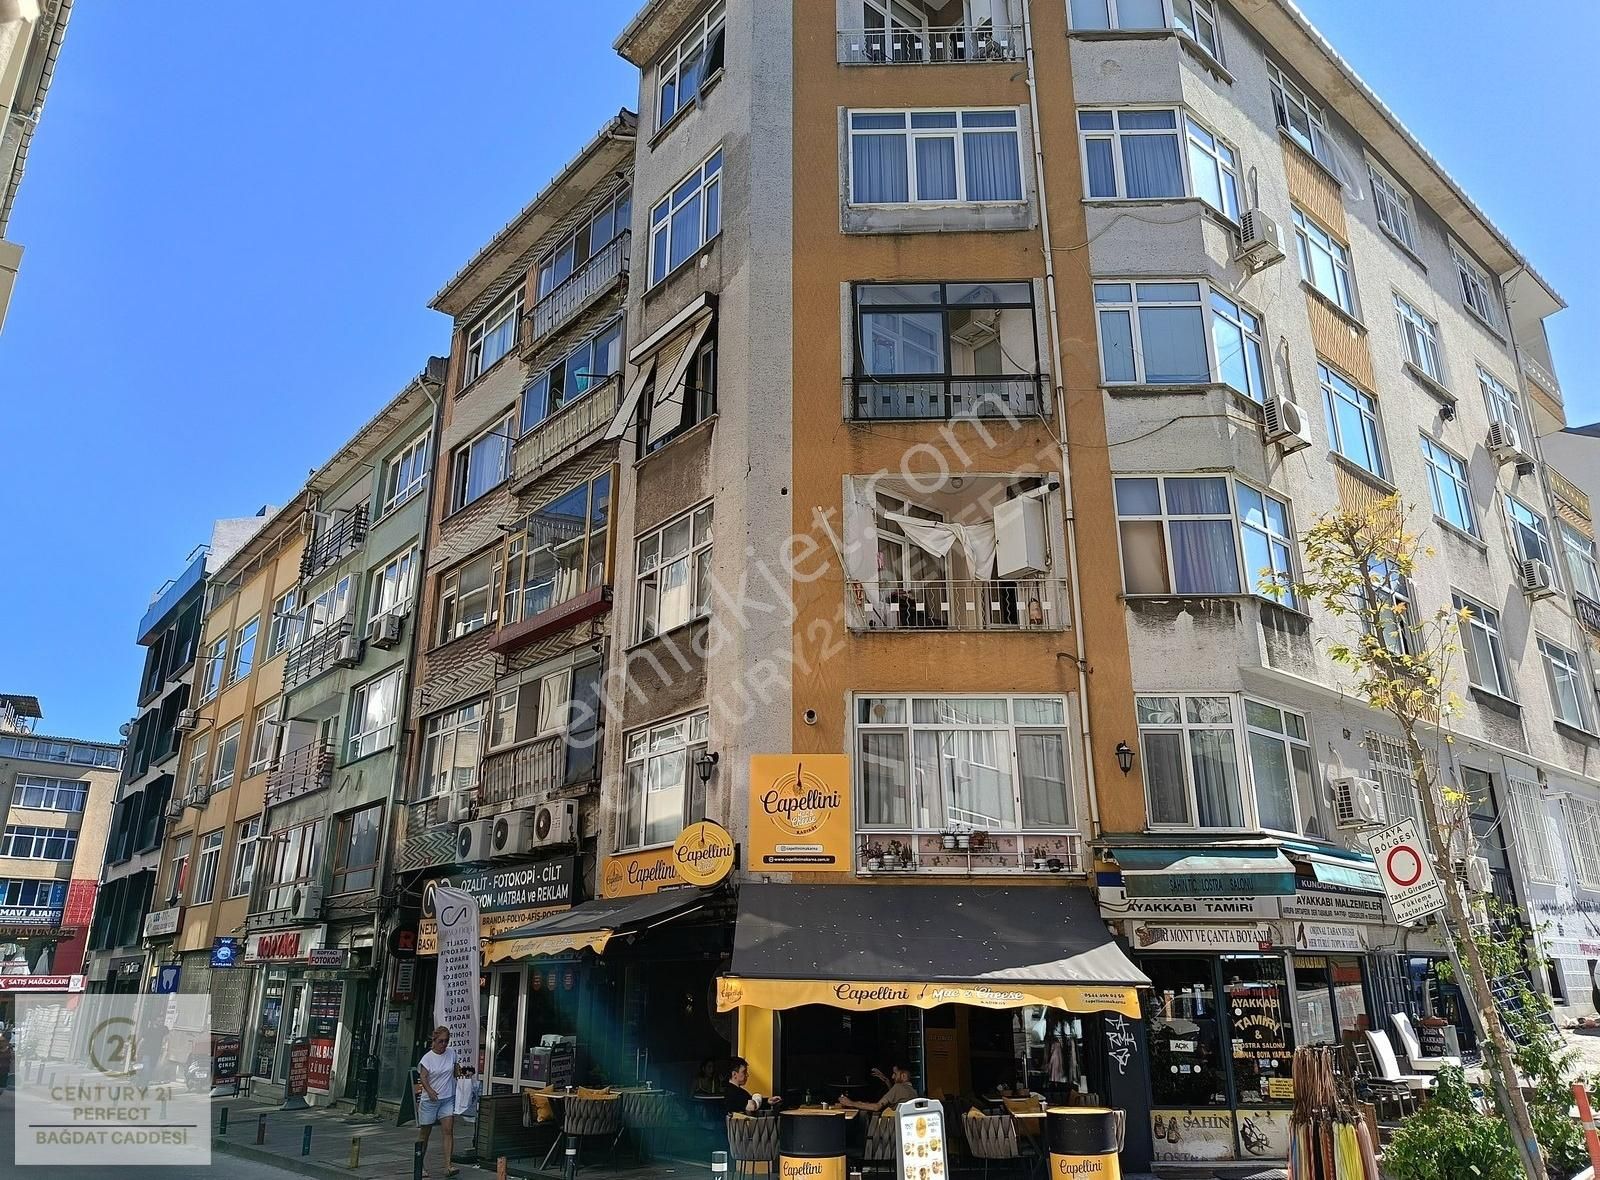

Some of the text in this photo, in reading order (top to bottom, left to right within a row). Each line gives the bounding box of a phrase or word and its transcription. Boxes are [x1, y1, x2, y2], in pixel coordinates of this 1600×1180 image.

[760, 789, 842, 820] Capellini
[1374, 829, 1415, 855] BÖLGESİ
[1379, 826, 1403, 841] YAYA
[675, 844, 733, 867] Capellini
[461, 863, 562, 893] OZALİT FOTOKOPİ CİLT
[627, 860, 676, 890] Capellini
[497, 890, 526, 906] MATBAA
[527, 892, 536, 903] ve
[537, 884, 569, 902] REKLAM
[1407, 880, 1435, 895] Giremez
[1127, 902, 1254, 913] AYAKKABI TAMİRİ
[1297, 896, 1334, 906] AYAKKABI
[1397, 906, 1425, 920] Araçları
[1424, 898, 1444, 910] Hariç
[1401, 893, 1432, 909] Yükleme
[29, 910, 61, 918] AJANS
[257, 933, 301, 958] KOPYACI
[417, 938, 436, 950] BASKI
[1170, 929, 1193, 943] MONT
[1195, 929, 1206, 943] VE
[1206, 929, 1237, 946] ÇANTA
[311, 955, 342, 964] FOTOKOPİ
[8, 978, 28, 986] SATIŞ
[28, 977, 69, 986] MAĞAZALARI
[833, 983, 910, 1005] Capellini
[932, 988, 960, 1001] Mac
[974, 985, 1025, 1001] Cheese
[1231, 998, 1280, 1008] AYAKKABI
[1255, 1030, 1262, 1039] &
[1182, 1113, 1231, 1130] ŞAHİN
[783, 1160, 823, 1177] Capellini
[1059, 1158, 1103, 1176] Capellini
